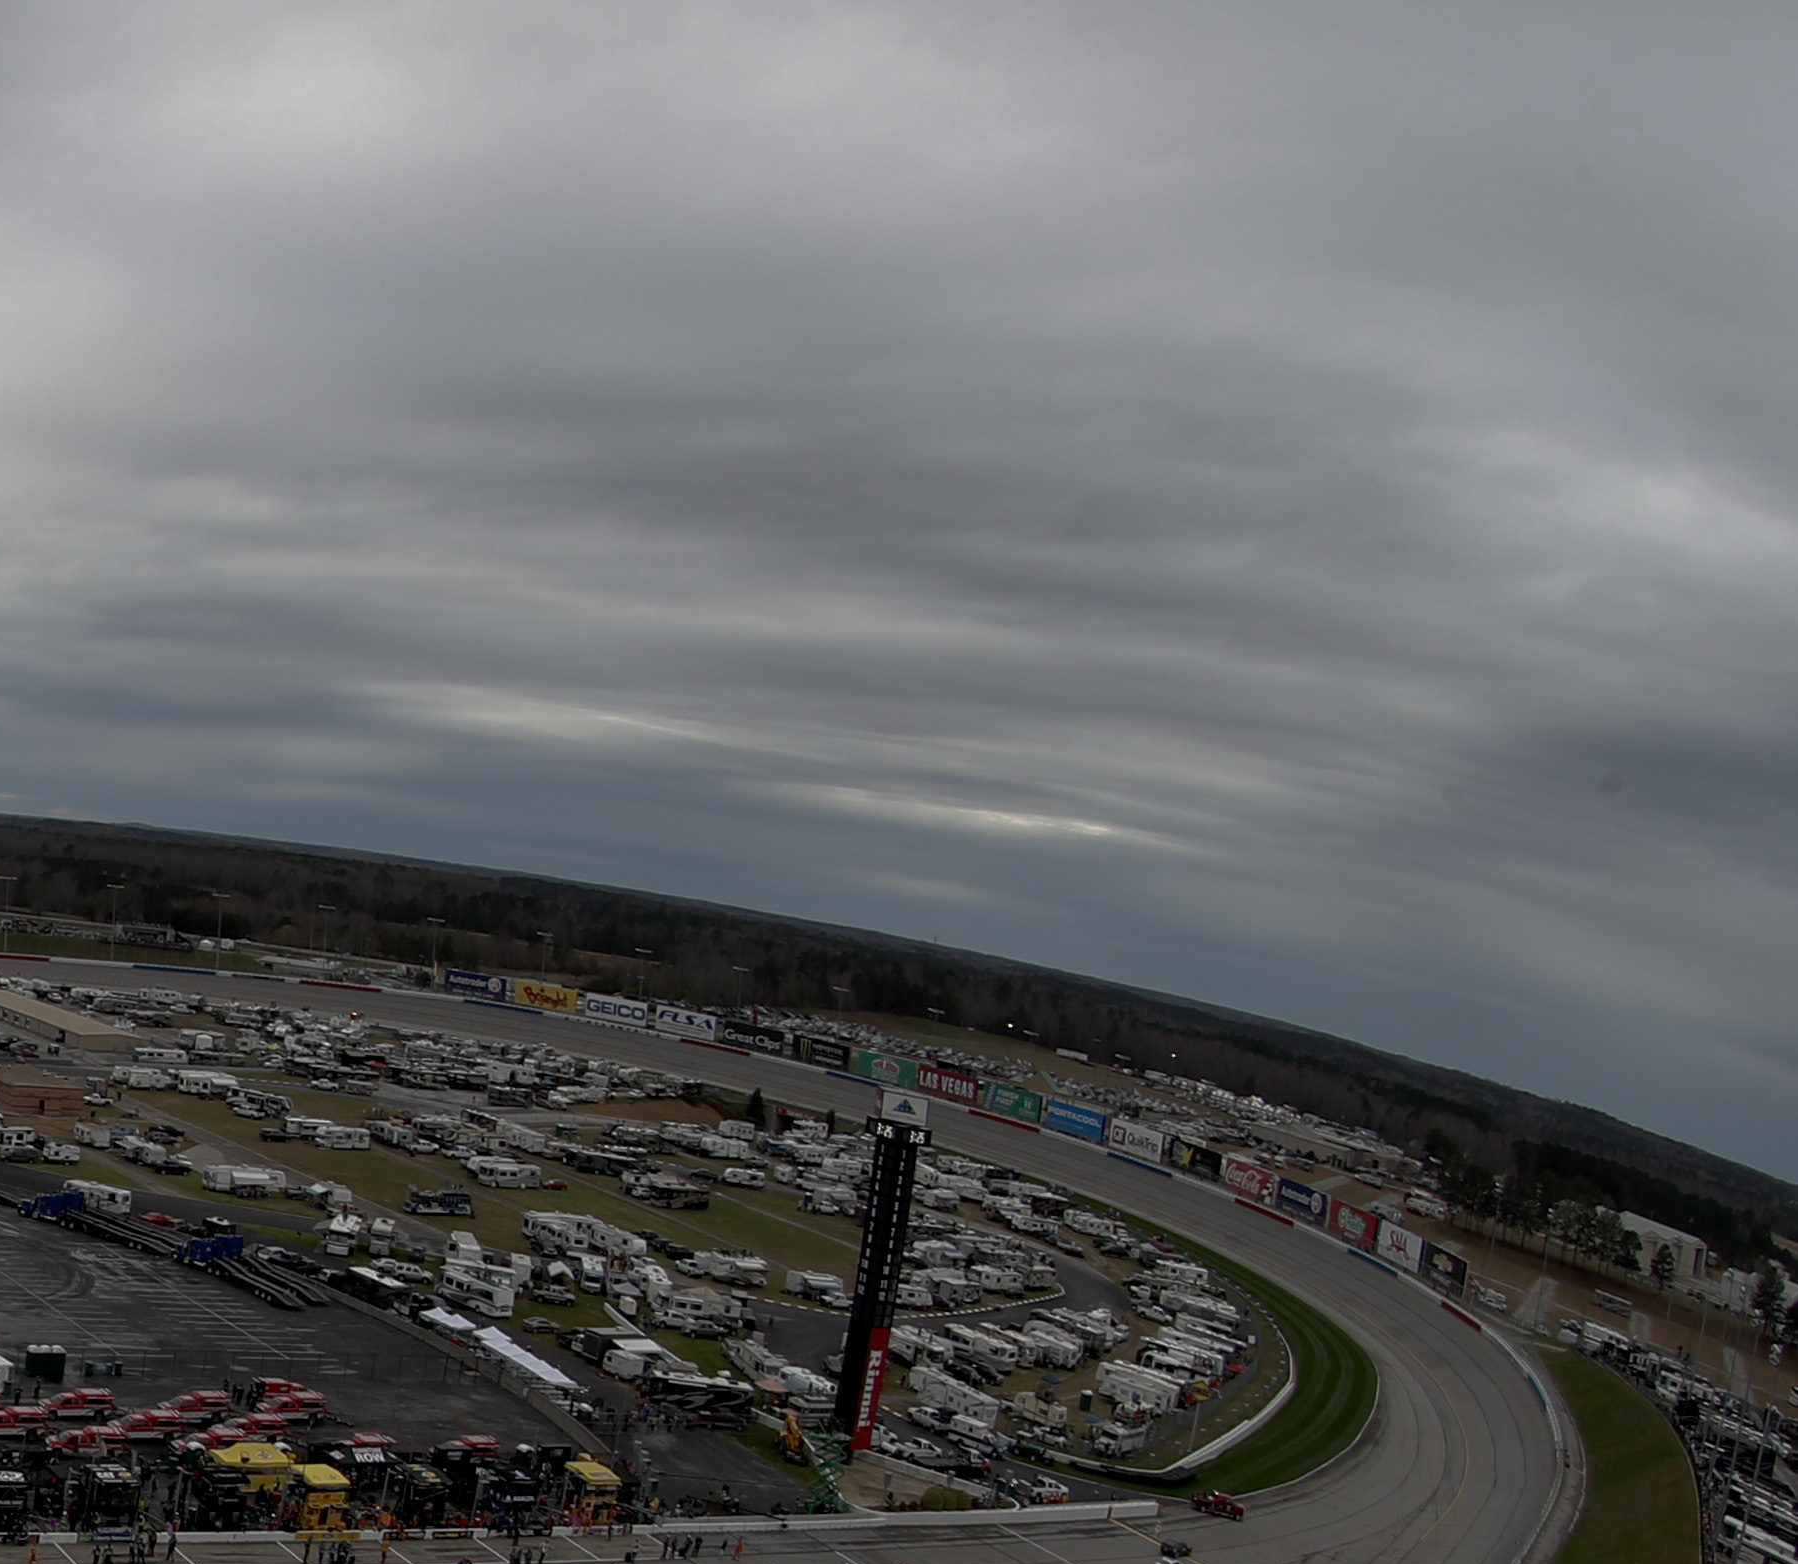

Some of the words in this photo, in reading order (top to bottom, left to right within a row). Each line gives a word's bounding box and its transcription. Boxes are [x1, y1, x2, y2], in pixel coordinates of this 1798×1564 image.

[587, 999, 645, 1021] GEICO
[724, 1027, 753, 1043] Great
[754, 1034, 781, 1050] Clips
[919, 1069, 939, 1088] LAS
[941, 1072, 975, 1099] VEGAS
[1048, 1104, 1102, 1129] PORTACOOL
[857, 1350, 882, 1428] Rinnai
[355, 1453, 387, 1463] ROW
